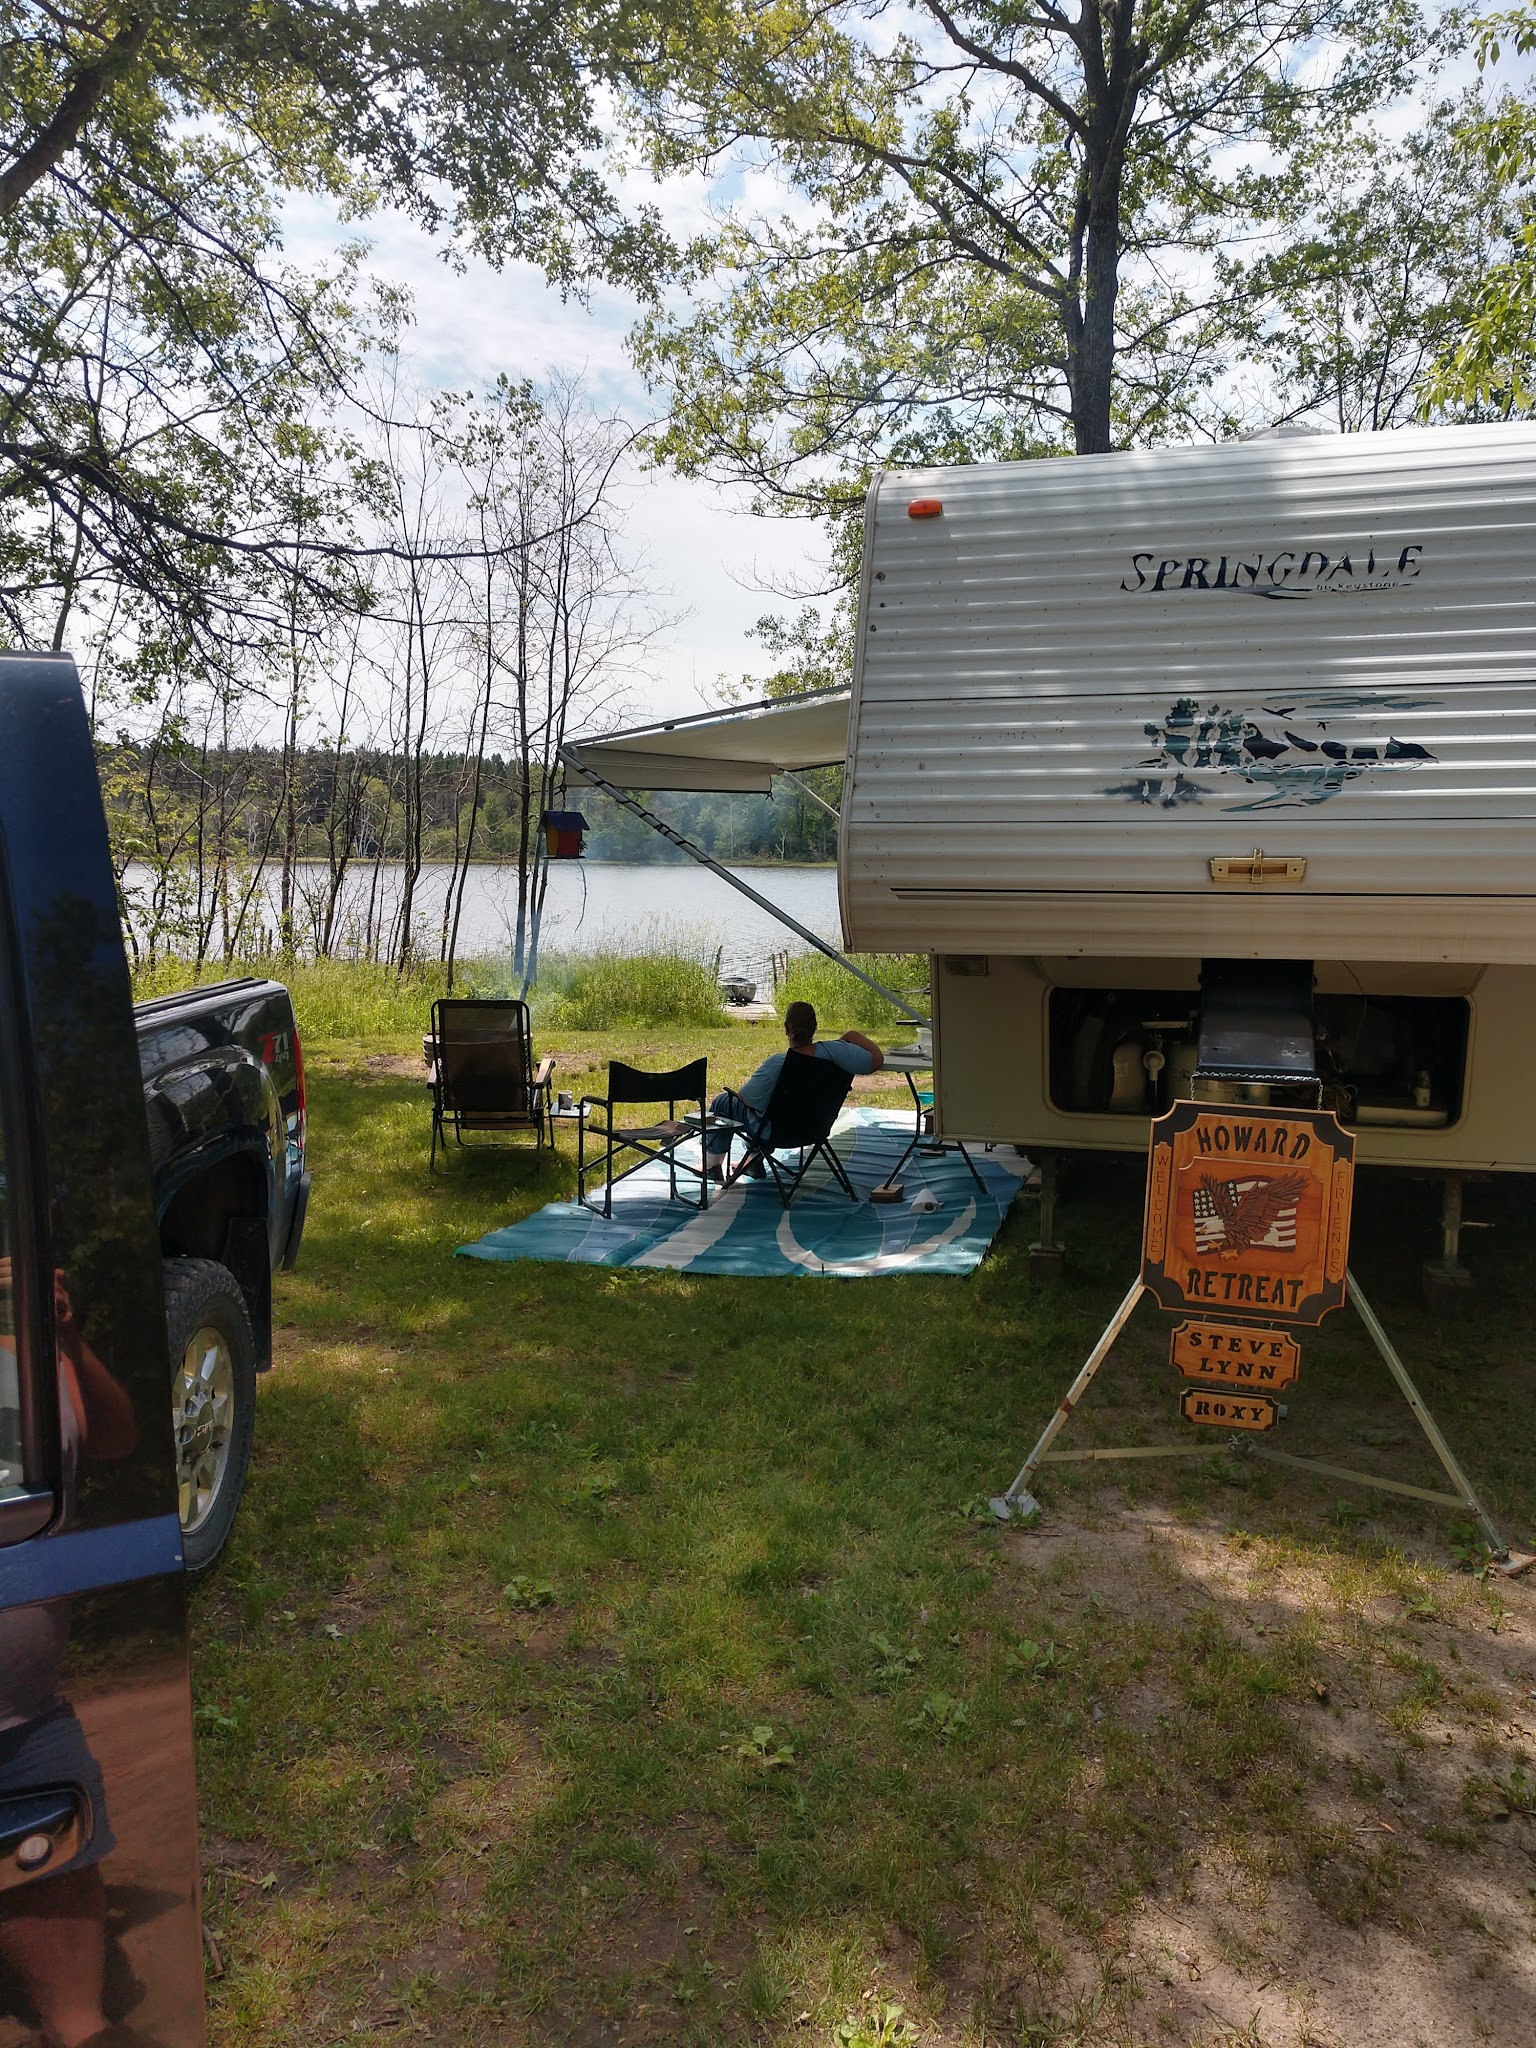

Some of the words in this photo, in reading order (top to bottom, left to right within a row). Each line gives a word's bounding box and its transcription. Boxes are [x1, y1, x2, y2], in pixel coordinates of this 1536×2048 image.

[1120, 546, 1423, 593] SPRINGDALE
[257, 1031, 289, 1064] Z71
[1196, 1125, 1311, 1160] HOWARD
[1150, 1154, 1170, 1253] WELCOME
[1330, 1171, 1347, 1274] FRIENDS
[1186, 1268, 1304, 1308] RETREAT
[1189, 1332, 1283, 1357] STEVE
[1198, 1357, 1277, 1380] LYNN
[1194, 1400, 1265, 1422] ROXY
